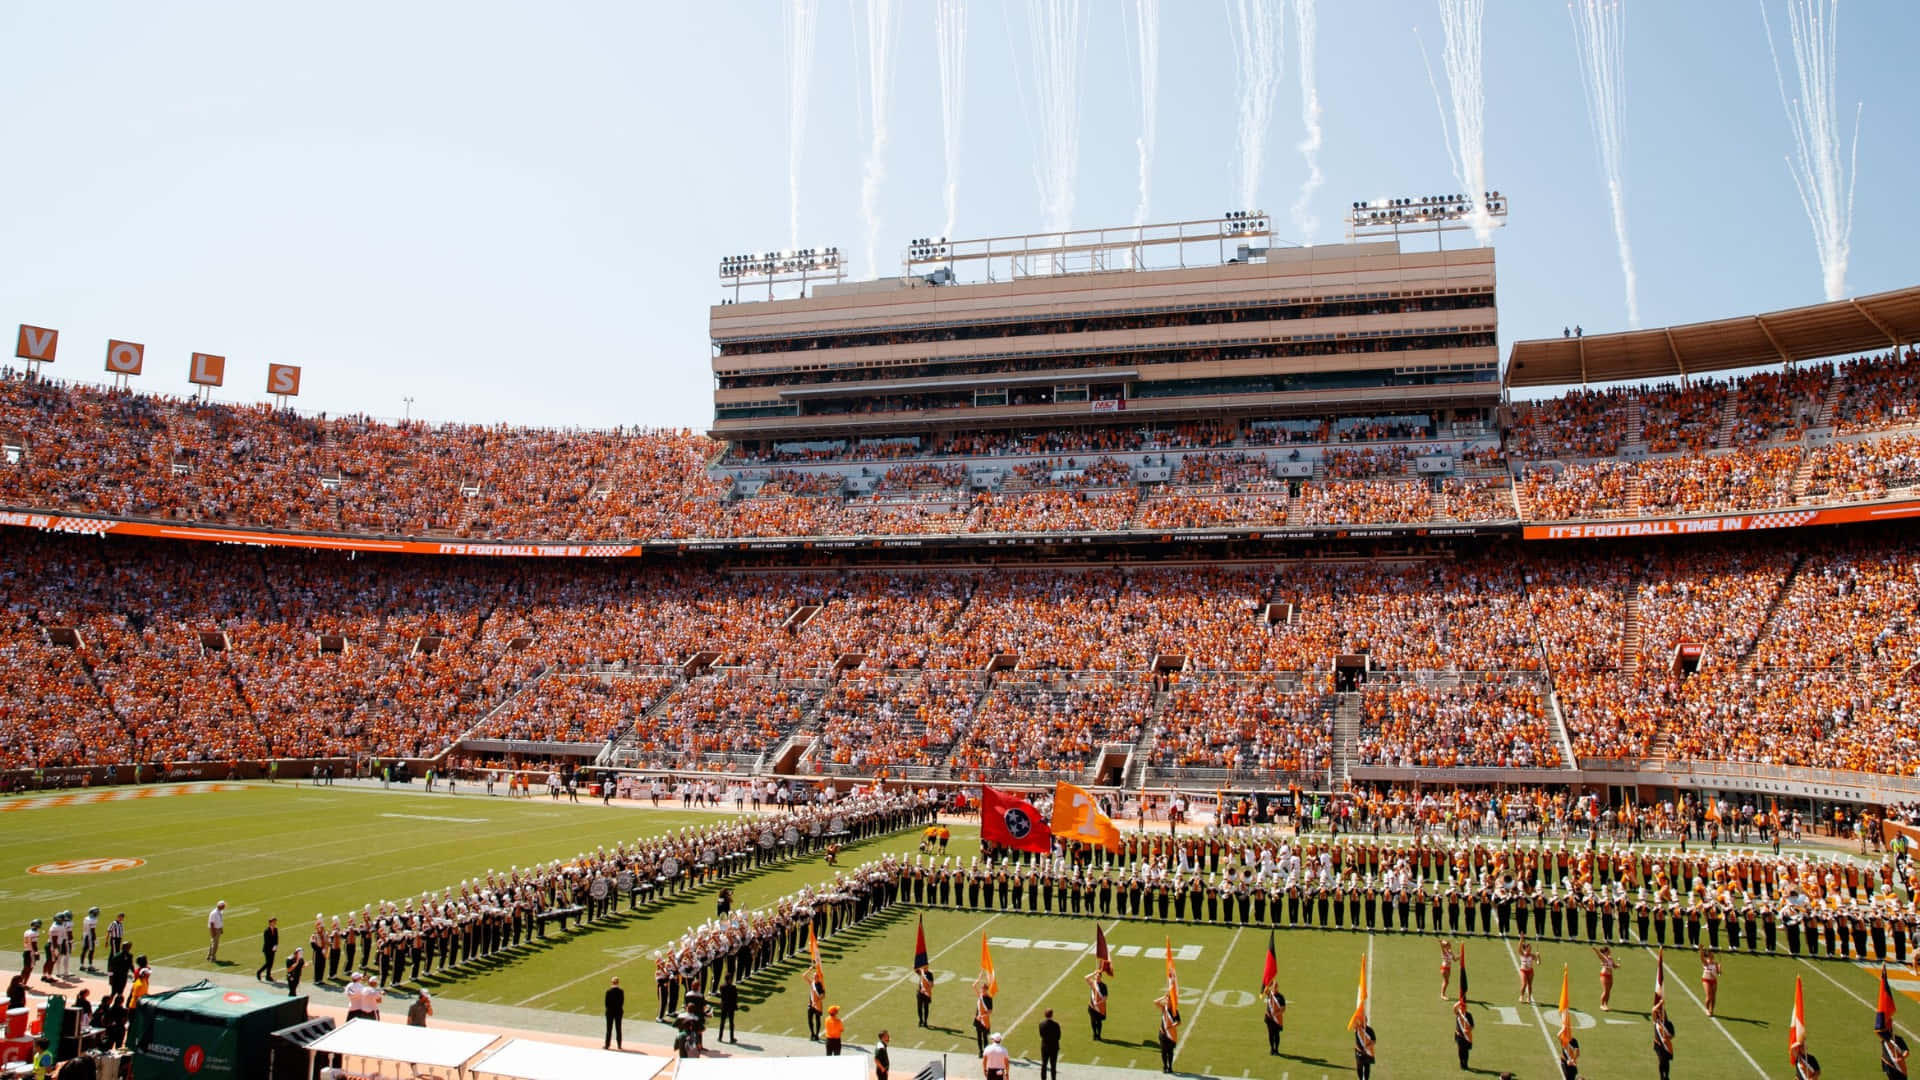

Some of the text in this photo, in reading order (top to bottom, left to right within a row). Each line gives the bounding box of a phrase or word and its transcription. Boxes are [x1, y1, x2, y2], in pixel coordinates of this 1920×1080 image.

[1549, 517, 1743, 538] IT'S FOOTBALL TIME IN
[440, 543, 582, 556] IT'S FOOTBALL TIME IN
[1488, 1006, 1597, 1030] 10
